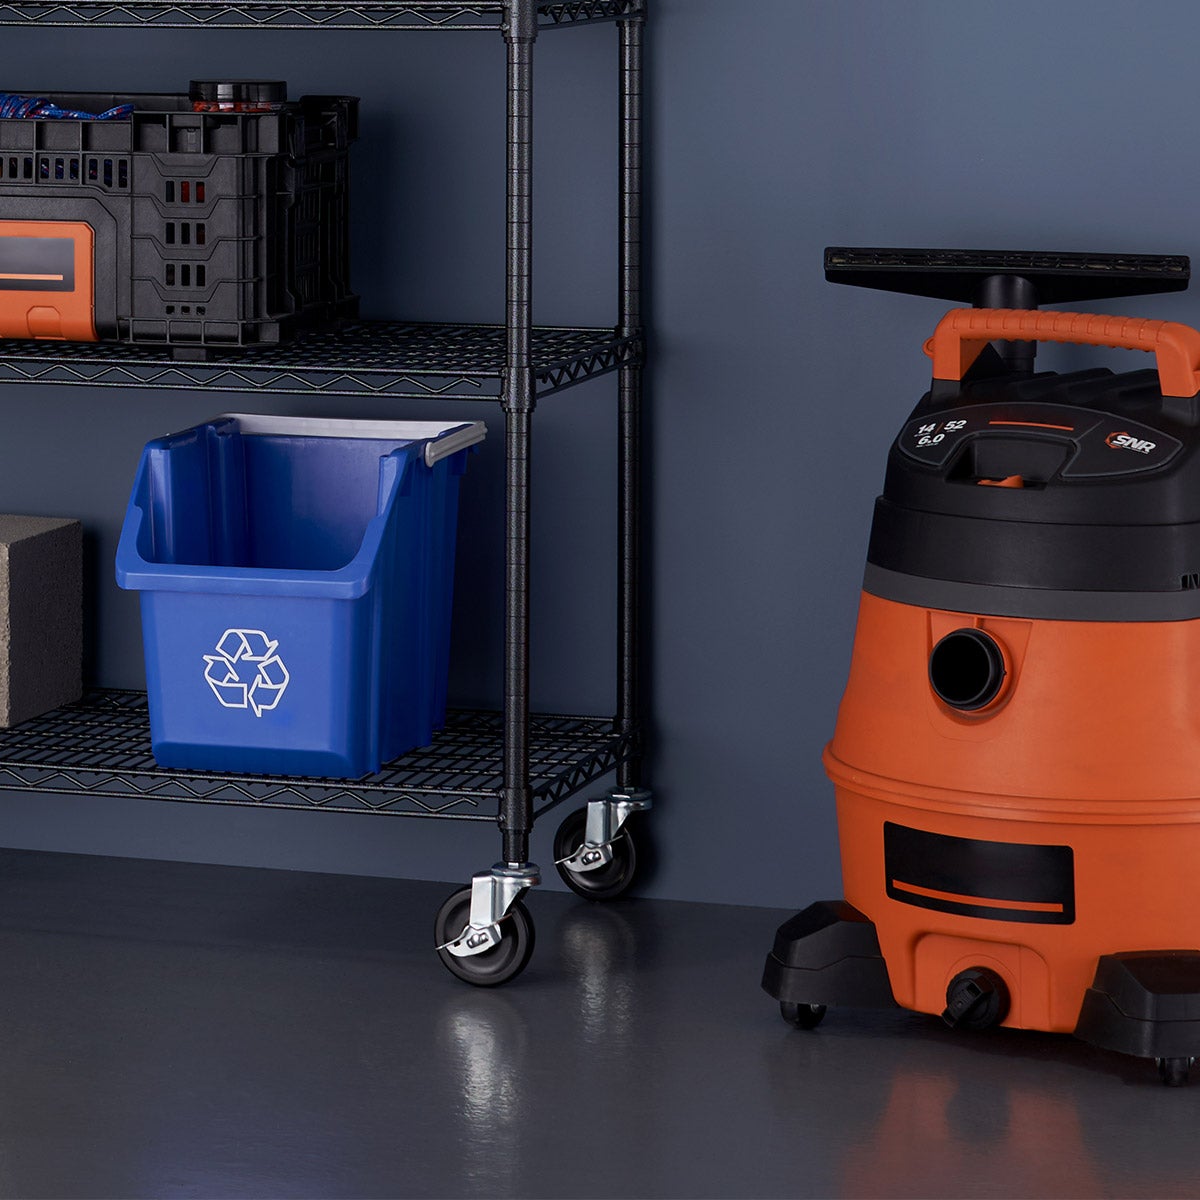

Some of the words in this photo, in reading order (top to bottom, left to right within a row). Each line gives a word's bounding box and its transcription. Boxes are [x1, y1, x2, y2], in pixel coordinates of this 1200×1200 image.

[918, 423, 936, 433] 14
[943, 420, 967, 430] 52
[918, 434, 945, 445] 6.0
[1111, 435, 1157, 453] SNR
